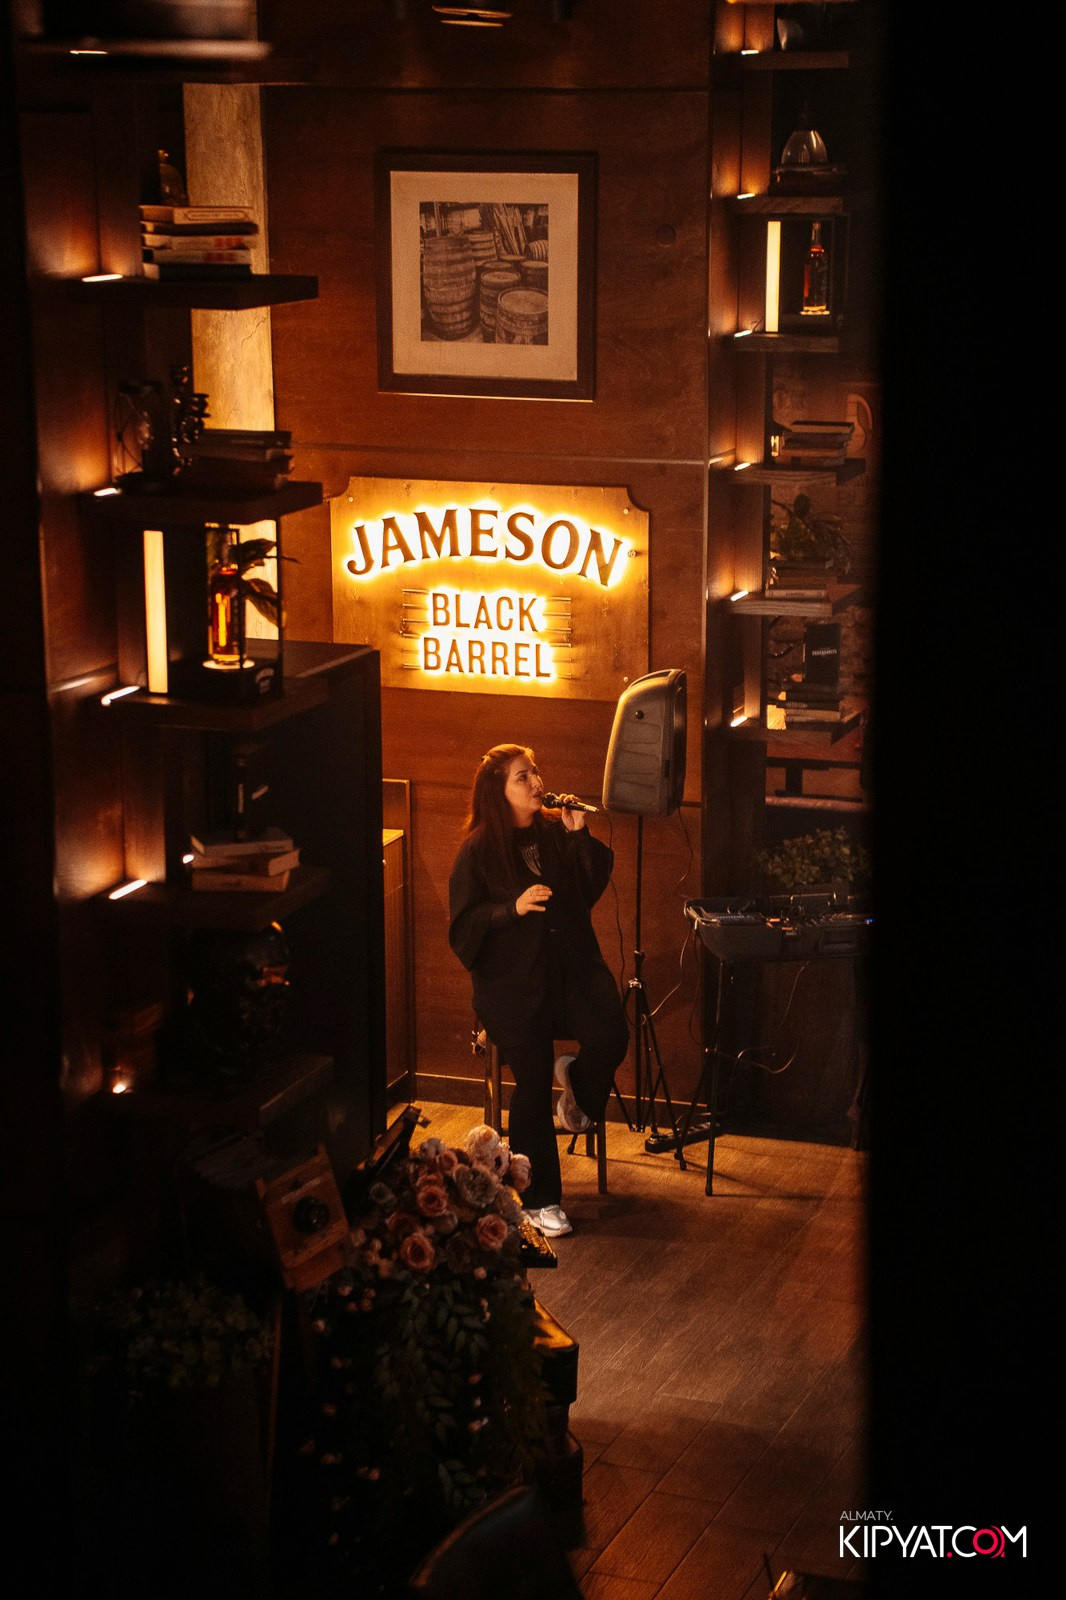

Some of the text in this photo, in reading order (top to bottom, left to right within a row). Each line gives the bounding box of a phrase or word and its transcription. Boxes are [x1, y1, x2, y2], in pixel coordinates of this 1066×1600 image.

[346, 508, 623, 587] JAMESON
[432, 593, 539, 632] BLACK
[423, 636, 551, 678] BARREL
